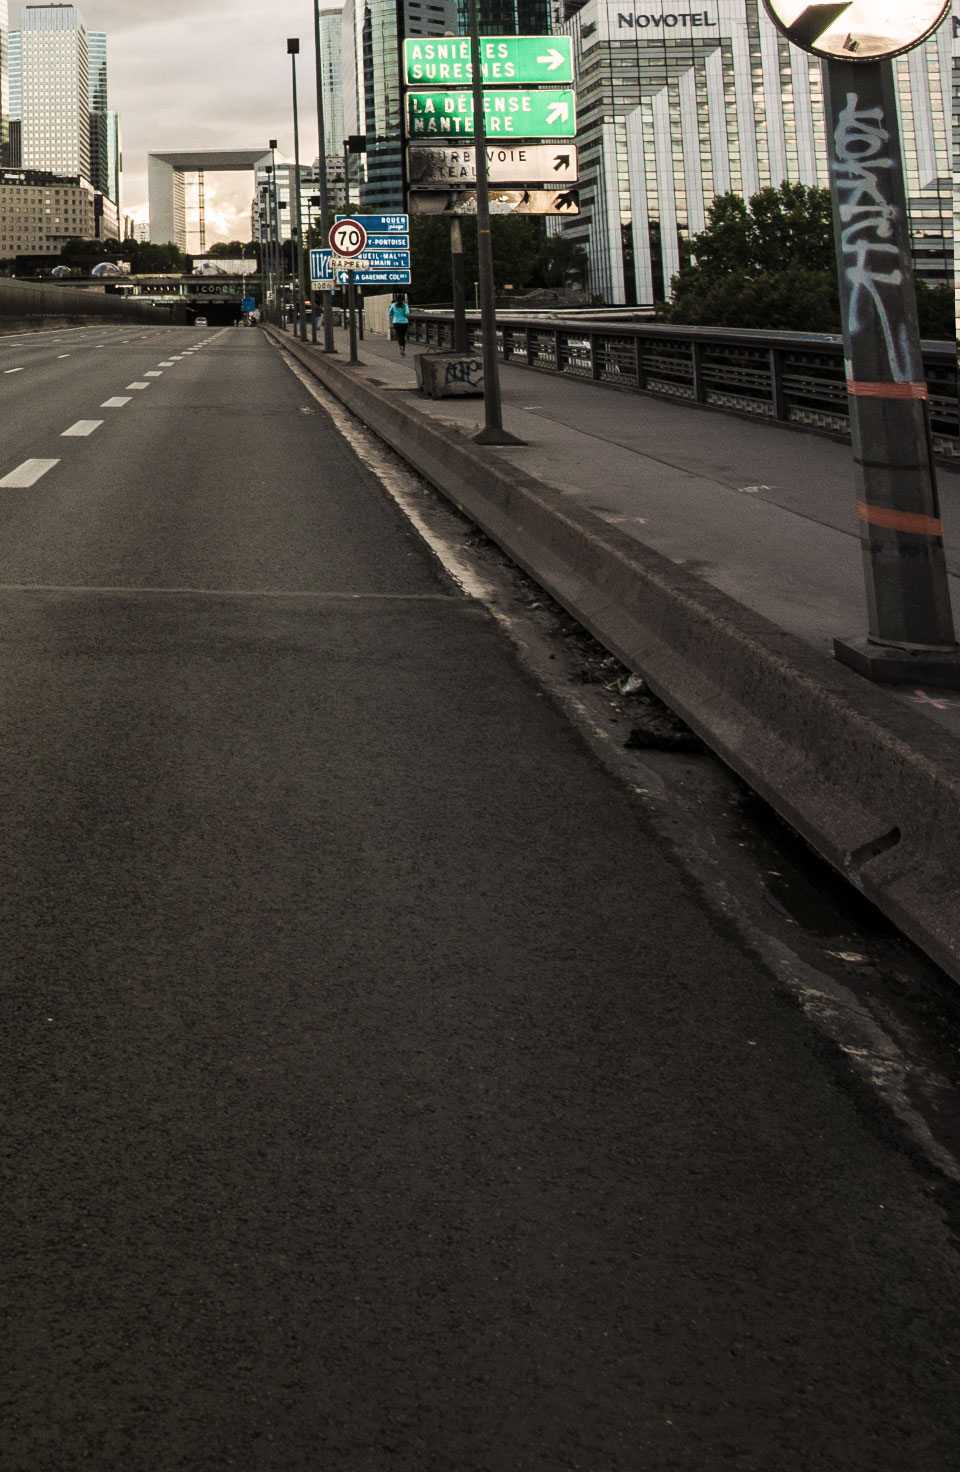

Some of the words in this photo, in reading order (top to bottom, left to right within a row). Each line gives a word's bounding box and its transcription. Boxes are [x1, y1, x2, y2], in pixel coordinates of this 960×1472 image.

[618, 11, 717, 28] NOVOTEL
[412, 42, 509, 60] ASNIÈES
[412, 62, 516, 79] SURESNES
[413, 98, 436, 114] LA
[414, 116, 514, 133] NANTERE
[338, 231, 359, 246] 70
[331, 259, 367, 269] RAPPEL
